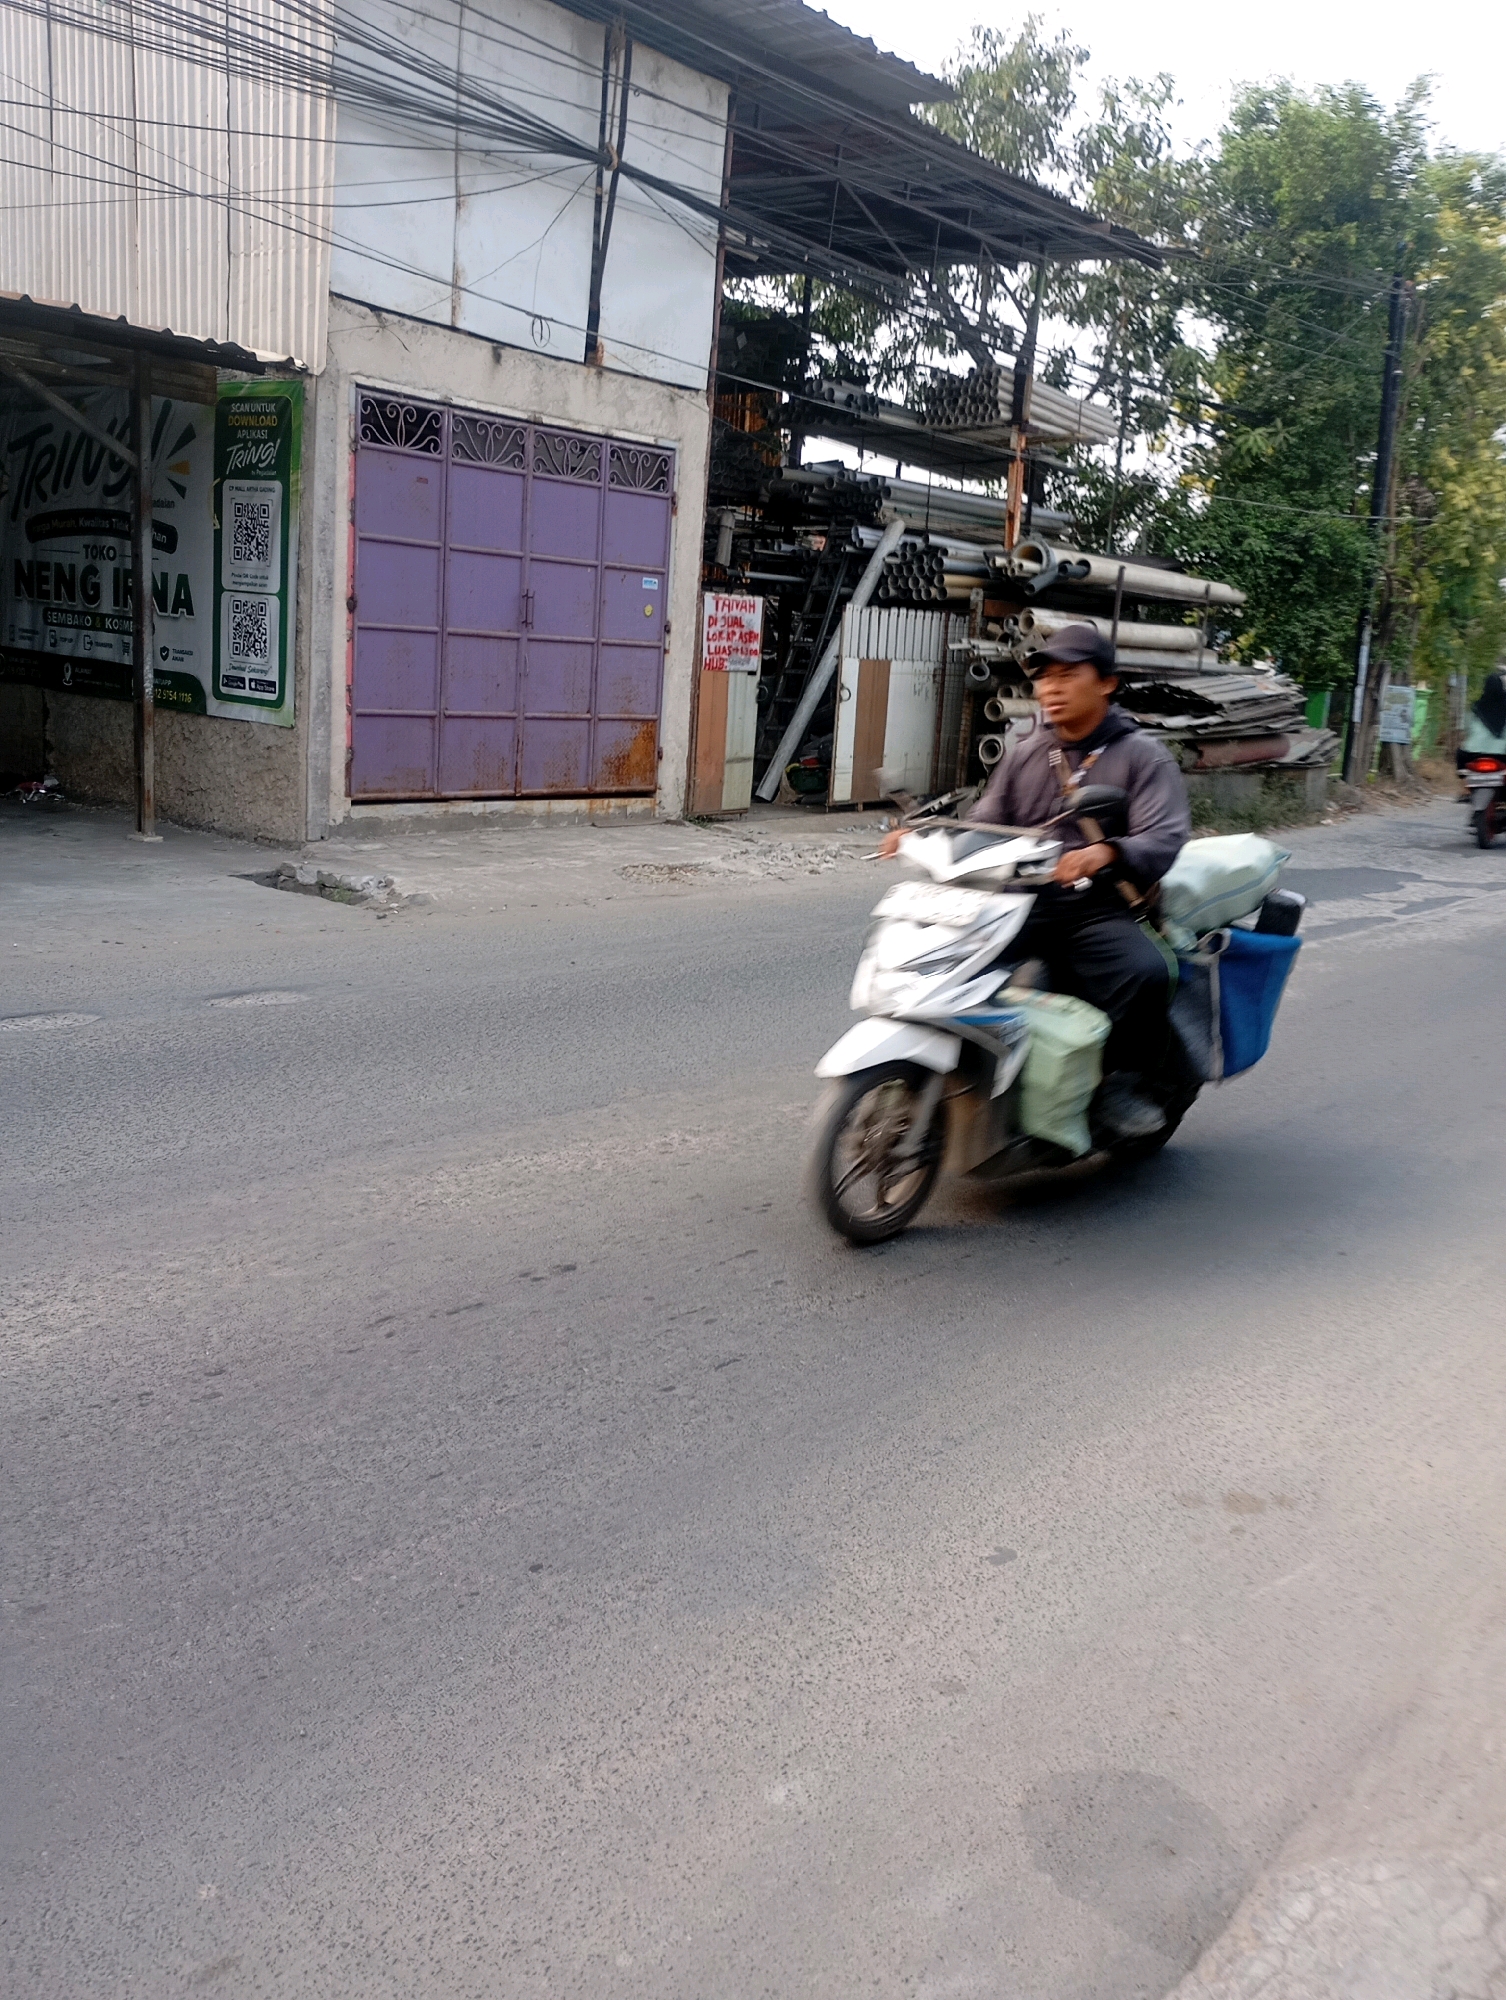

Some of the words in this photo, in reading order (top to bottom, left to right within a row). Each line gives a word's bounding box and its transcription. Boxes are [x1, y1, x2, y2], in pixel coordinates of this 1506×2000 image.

[231, 403, 250, 412] SCAN
[250, 402, 276, 412] UNTUK
[228, 414, 278, 426] DOWNLOAD
[236, 429, 268, 439] APLIKASI
[83, 544, 117, 561] TOKO
[14, 558, 101, 606] NENG
[713, 595, 756, 613] TANAH
[47, 611, 92, 627] SEMBAKO
[94, 616, 101, 628] &
